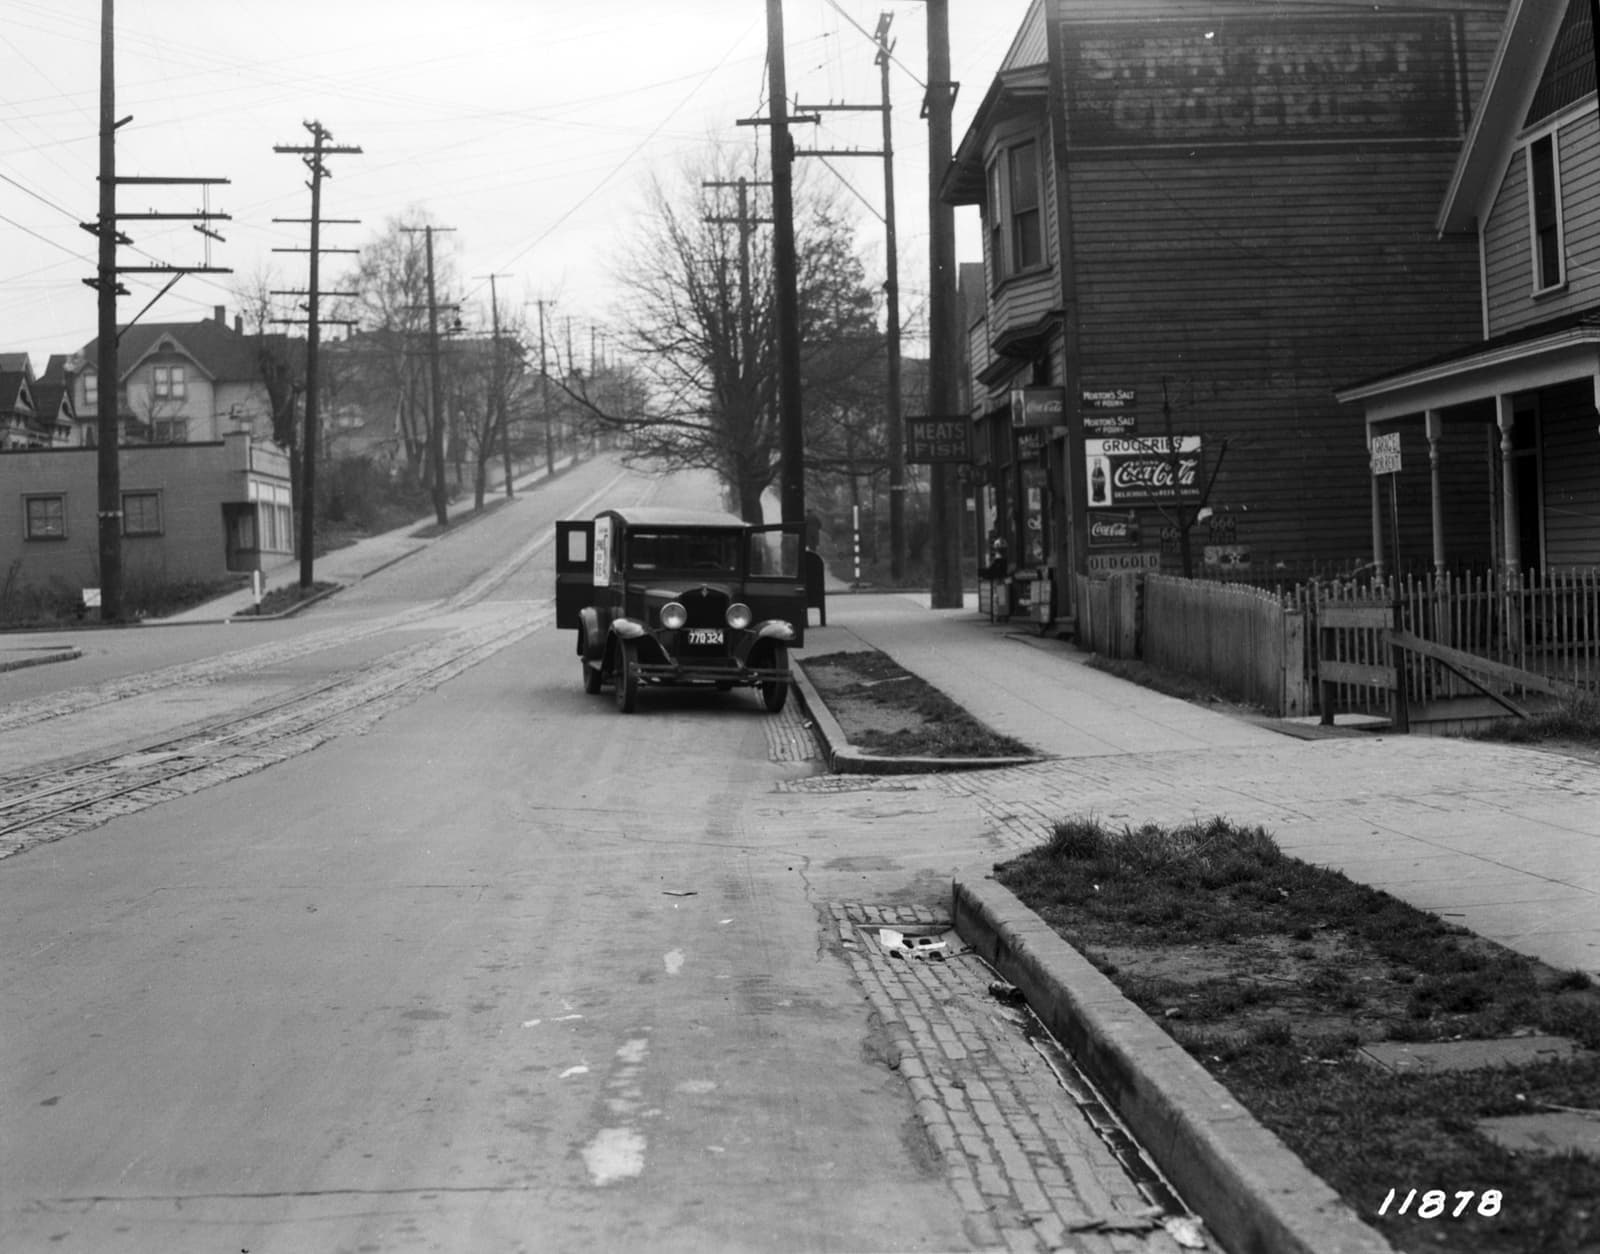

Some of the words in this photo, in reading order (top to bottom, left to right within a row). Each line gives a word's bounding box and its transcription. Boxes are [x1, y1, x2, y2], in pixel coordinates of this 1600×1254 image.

[913, 422, 965, 440] MEATS
[914, 441, 966, 457] FISH
[1091, 522, 1127, 536] Coca-Cola
